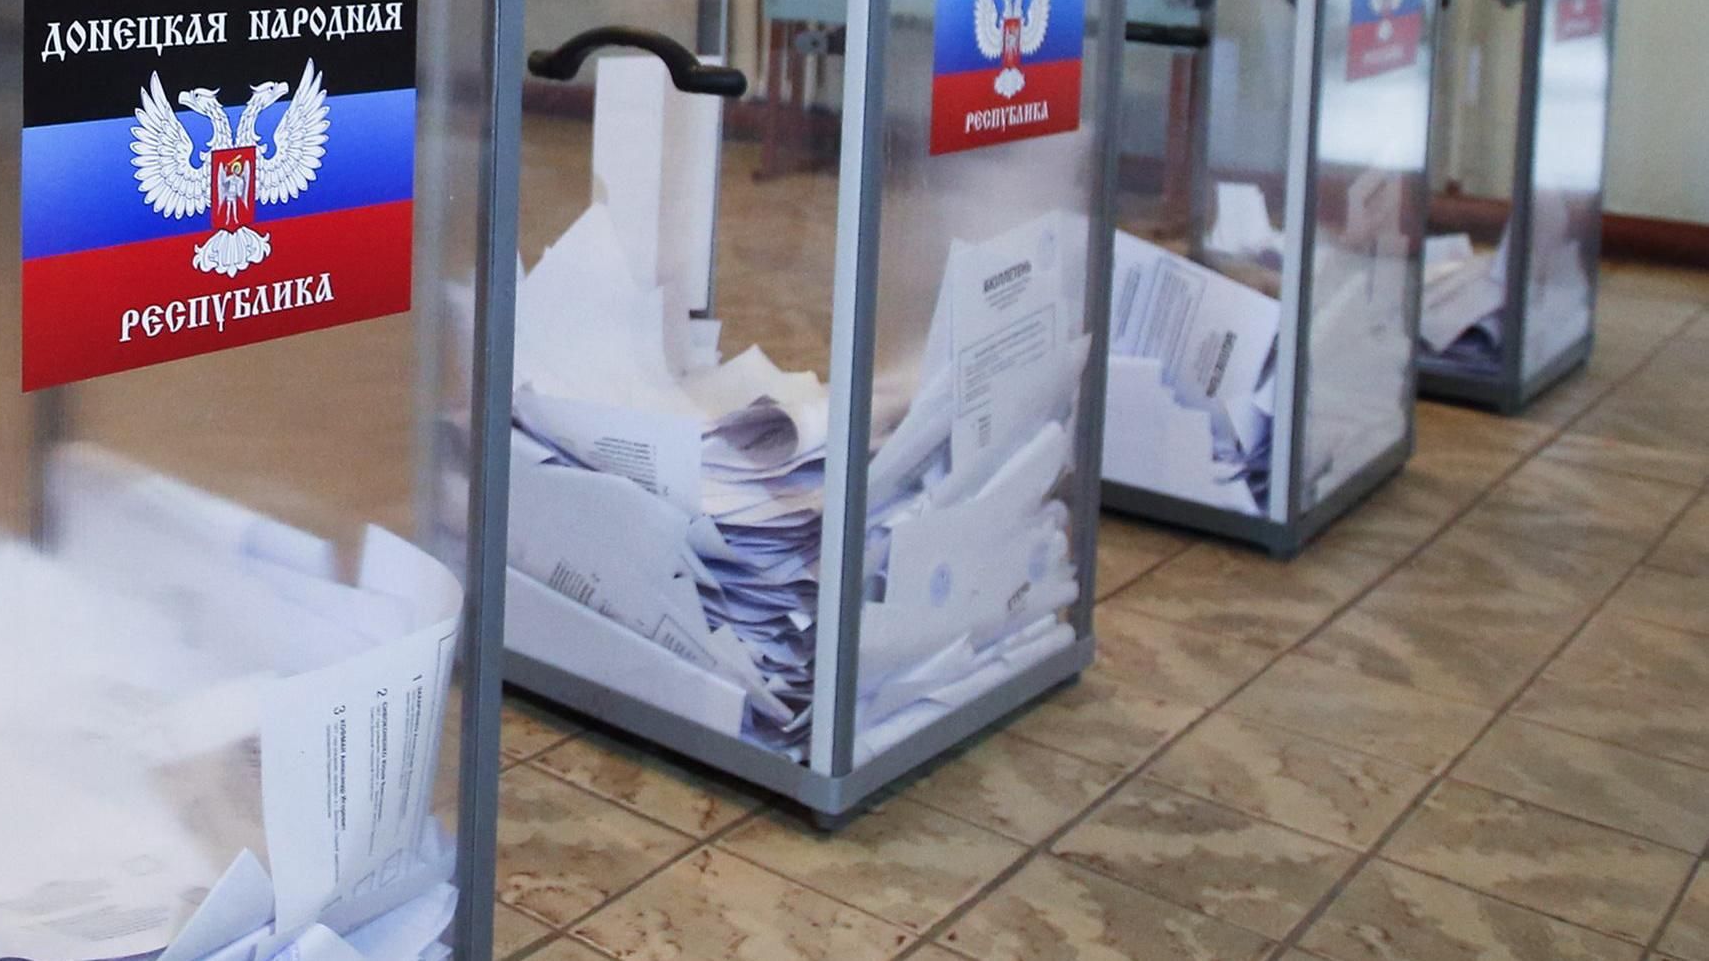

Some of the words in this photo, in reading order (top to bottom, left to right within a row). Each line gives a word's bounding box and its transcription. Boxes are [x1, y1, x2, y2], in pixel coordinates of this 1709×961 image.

[41, 11, 228, 63] ДОНЕЦКАЯ
[247, 1, 404, 42] НАРОДНАЯ
[963, 100, 1050, 134] РЕСПУБЛИКА
[118, 272, 335, 343] РЕСПУБЛИКА
[376, 687, 388, 698] 2
[333, 704, 347, 717] 3
